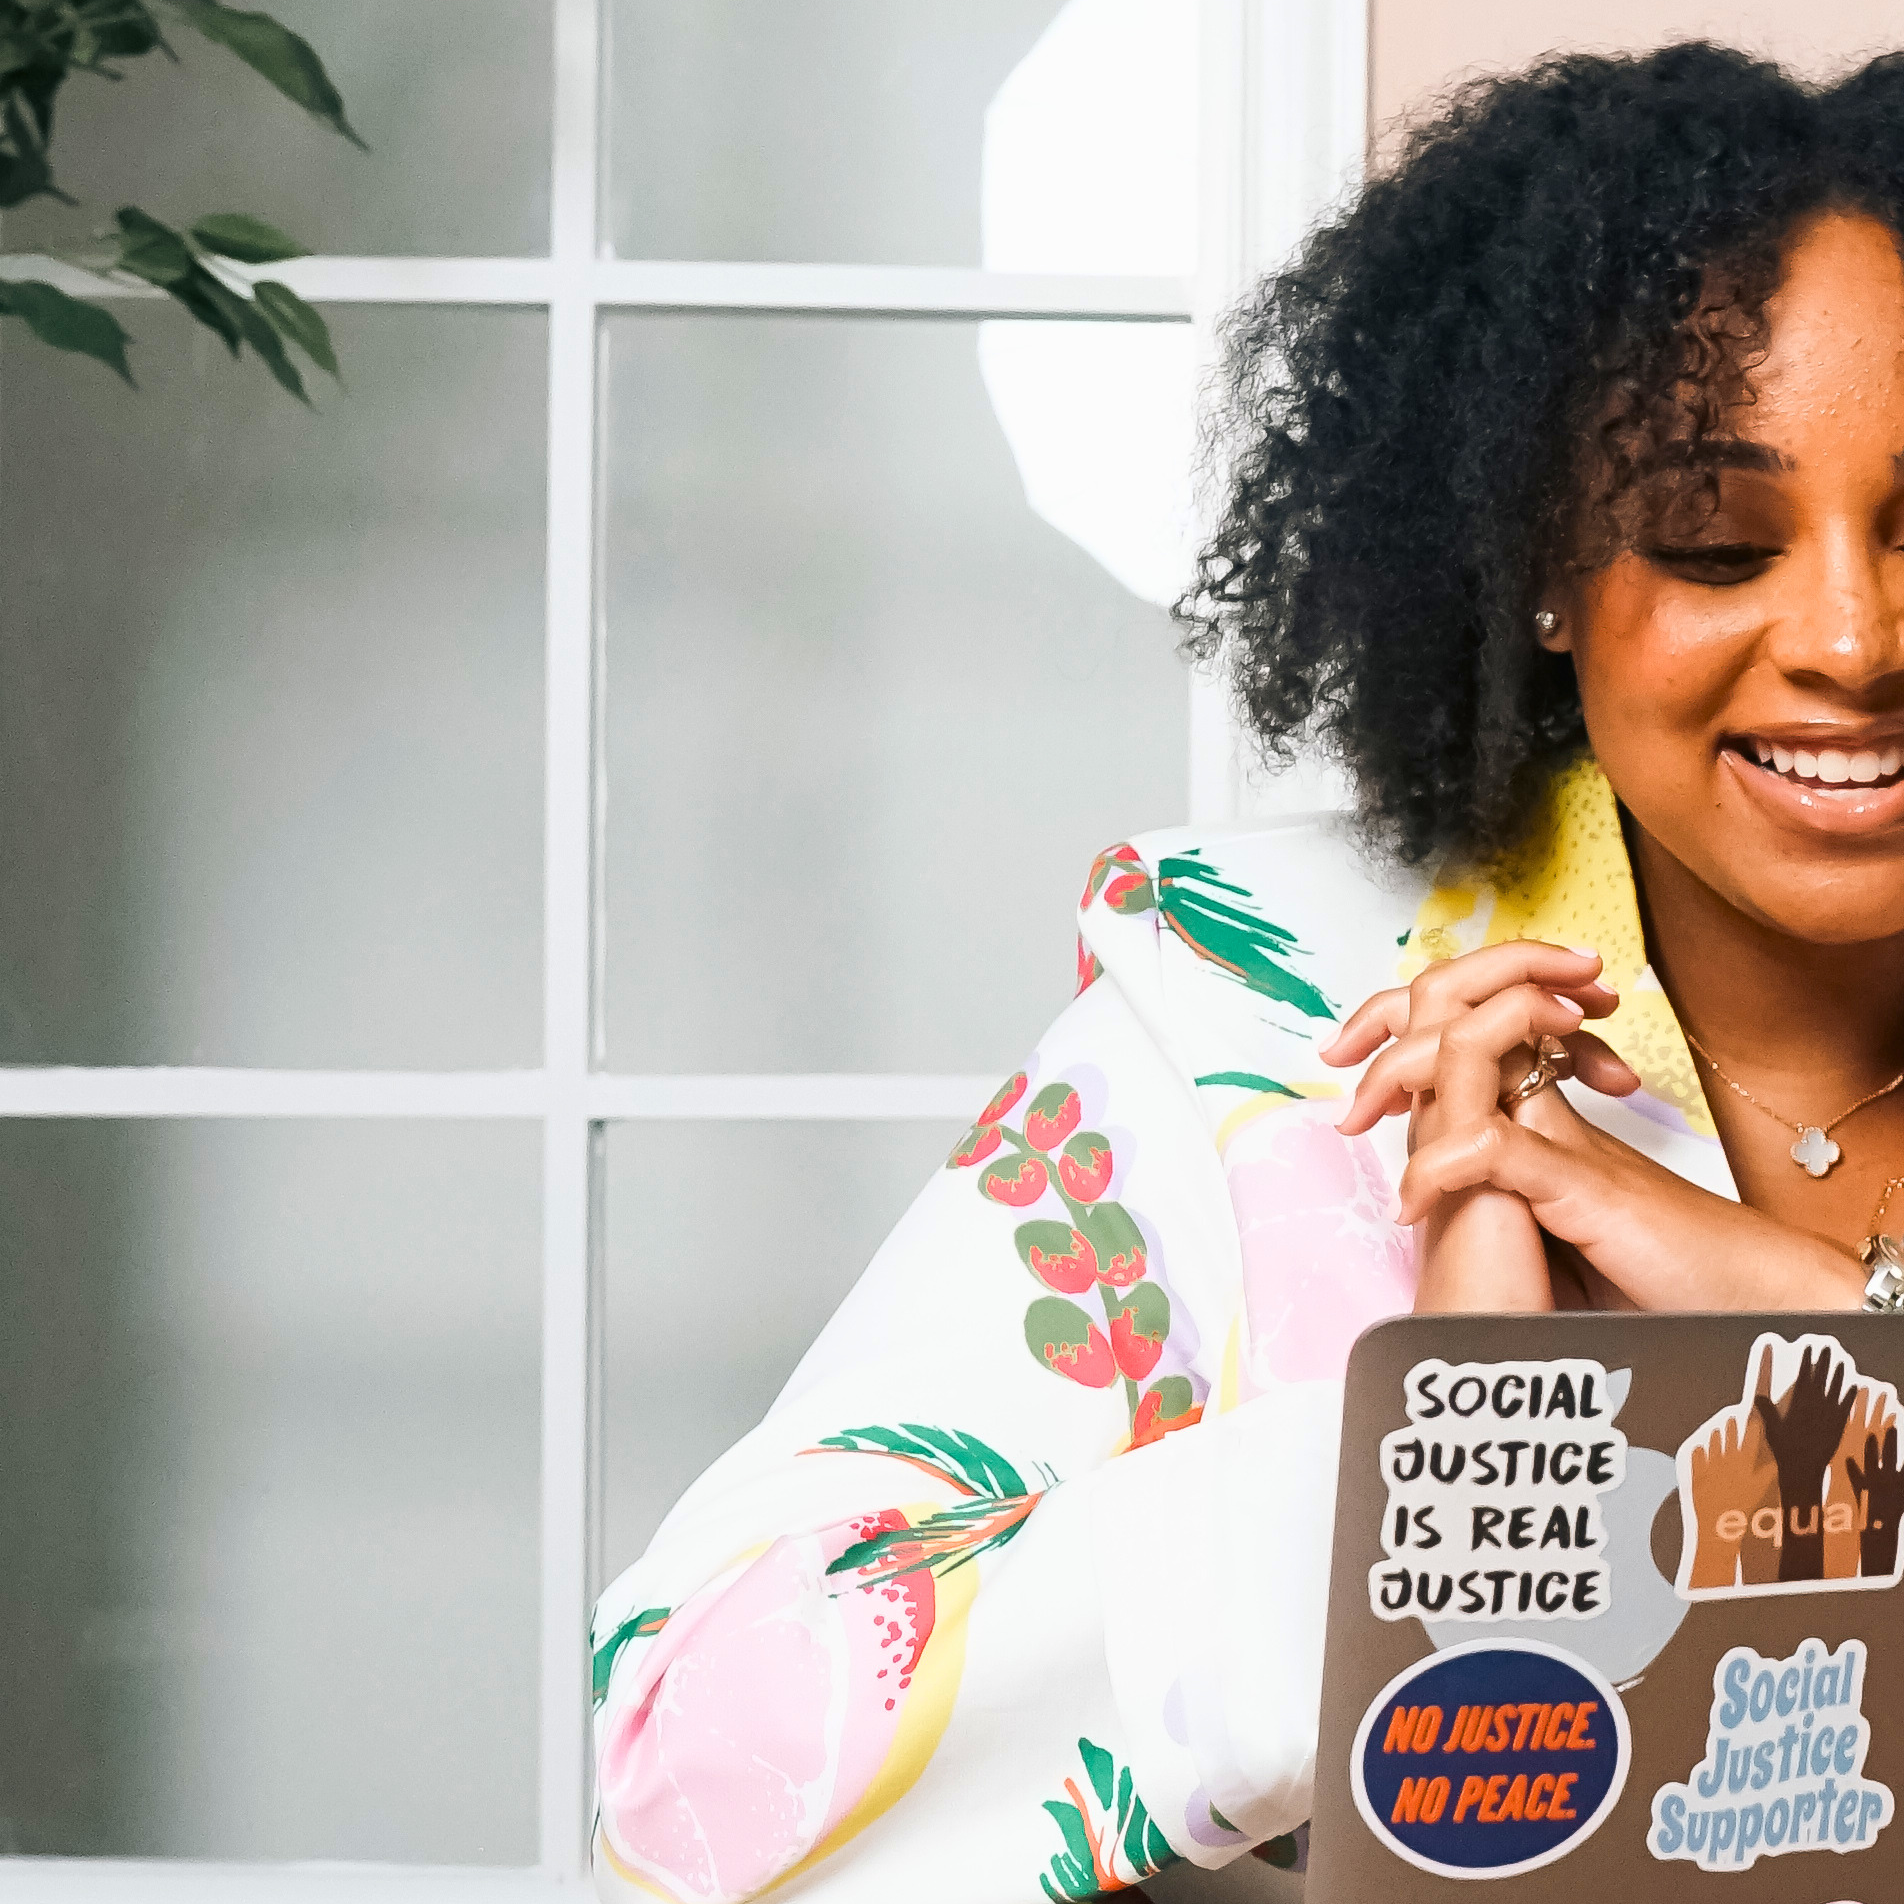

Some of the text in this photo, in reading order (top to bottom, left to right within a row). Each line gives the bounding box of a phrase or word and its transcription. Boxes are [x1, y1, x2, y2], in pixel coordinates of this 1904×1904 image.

[1417, 1372, 1602, 1419] SOCIAL
[1393, 1438, 1615, 1487] JUSTICE
[1395, 1505, 1597, 1550] IS REAL
[1715, 1489, 1883, 1547] equal.
[1381, 1567, 1601, 1614] JUSTICE
[1720, 1649, 1855, 1729] Social
[1383, 1705, 1444, 1754] NO
[1697, 1712, 1858, 1798] Justice
[1391, 1776, 1451, 1824] NO
[1657, 1778, 1882, 1863] Supporter
